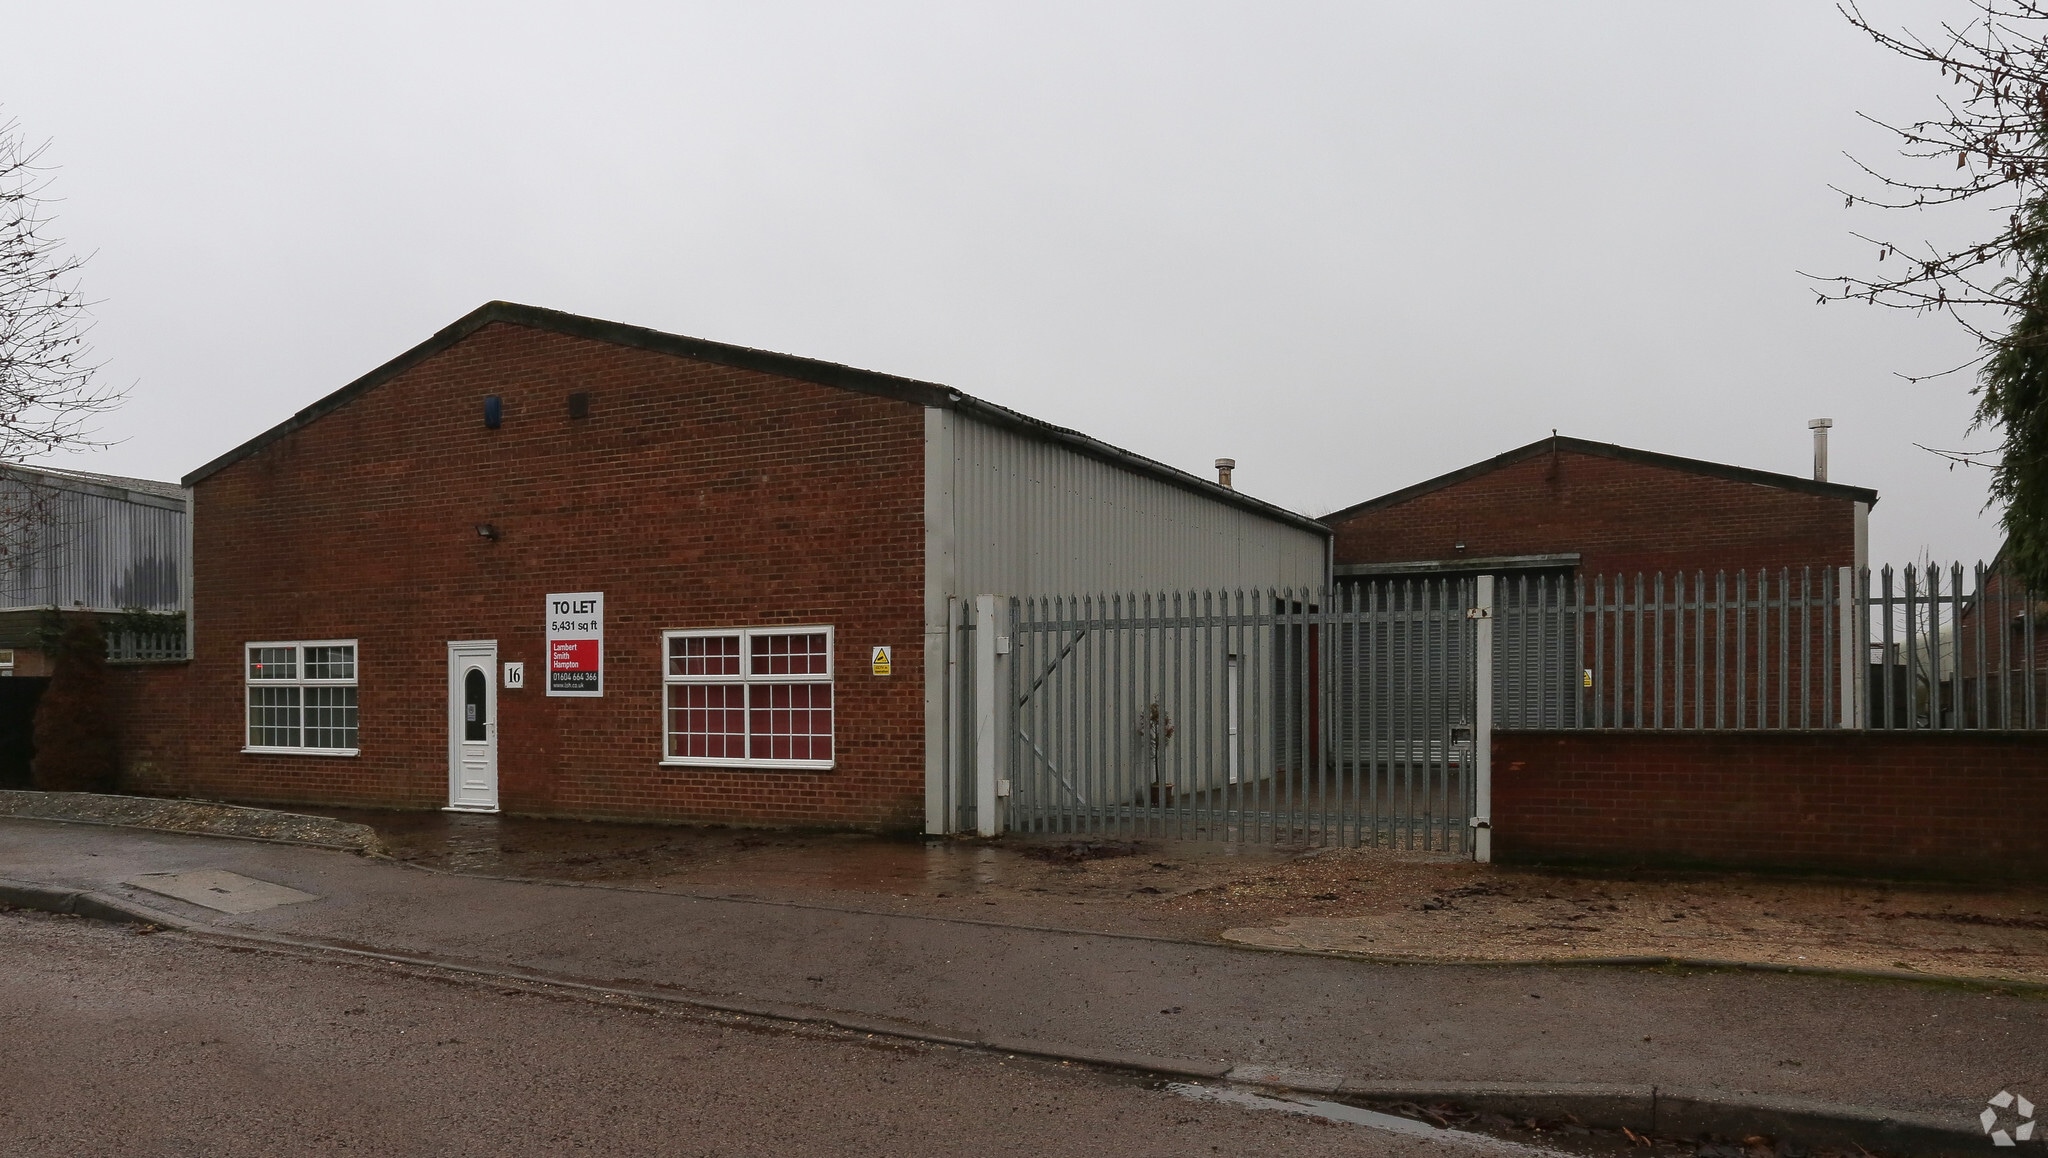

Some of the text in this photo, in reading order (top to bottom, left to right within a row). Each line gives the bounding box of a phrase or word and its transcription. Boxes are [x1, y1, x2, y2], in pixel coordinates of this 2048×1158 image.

[552, 600, 596, 614] TO LET
[552, 620, 598, 632] 5,431 sq ft
[553, 643, 578, 651] Lambert
[553, 652, 570, 660] Smith
[553, 660, 579, 669] Hampton
[508, 667, 521, 683] 16
[553, 672, 598, 681] 01604 664 366
